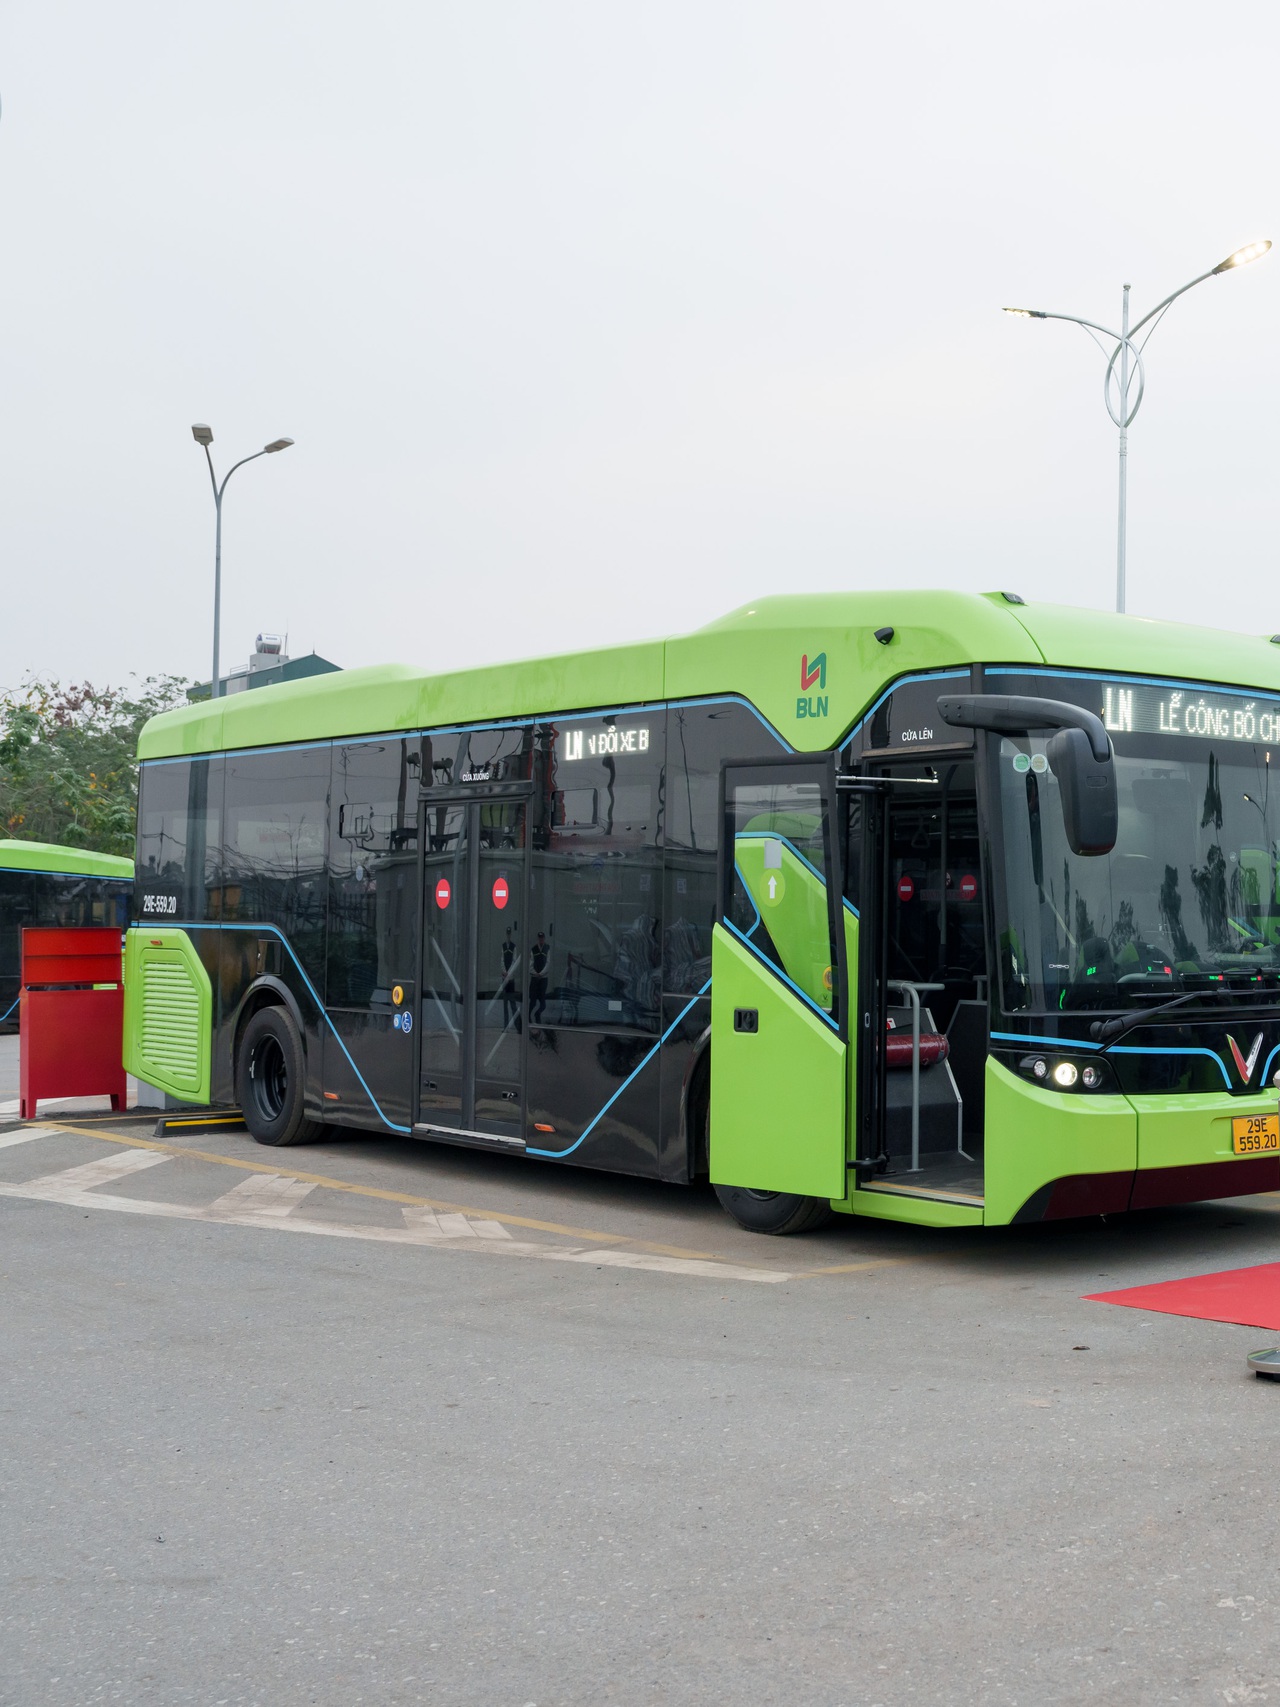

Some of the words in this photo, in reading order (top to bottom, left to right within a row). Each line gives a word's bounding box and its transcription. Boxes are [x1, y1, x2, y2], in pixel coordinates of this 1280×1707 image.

[796, 696, 829, 719] BLN
[1159, 693, 1182, 732] LỄ
[1185, 699, 1229, 736] CÔNG
[1233, 702, 1256, 739] BỐ
[620, 731, 637, 752] XE
[901, 731, 917, 742] CỬA
[918, 727, 933, 740] LÊN
[143, 895, 177, 914] 29E-559.20
[1246, 1118, 1268, 1134] 29E
[1239, 1133, 1277, 1151] 559.20
